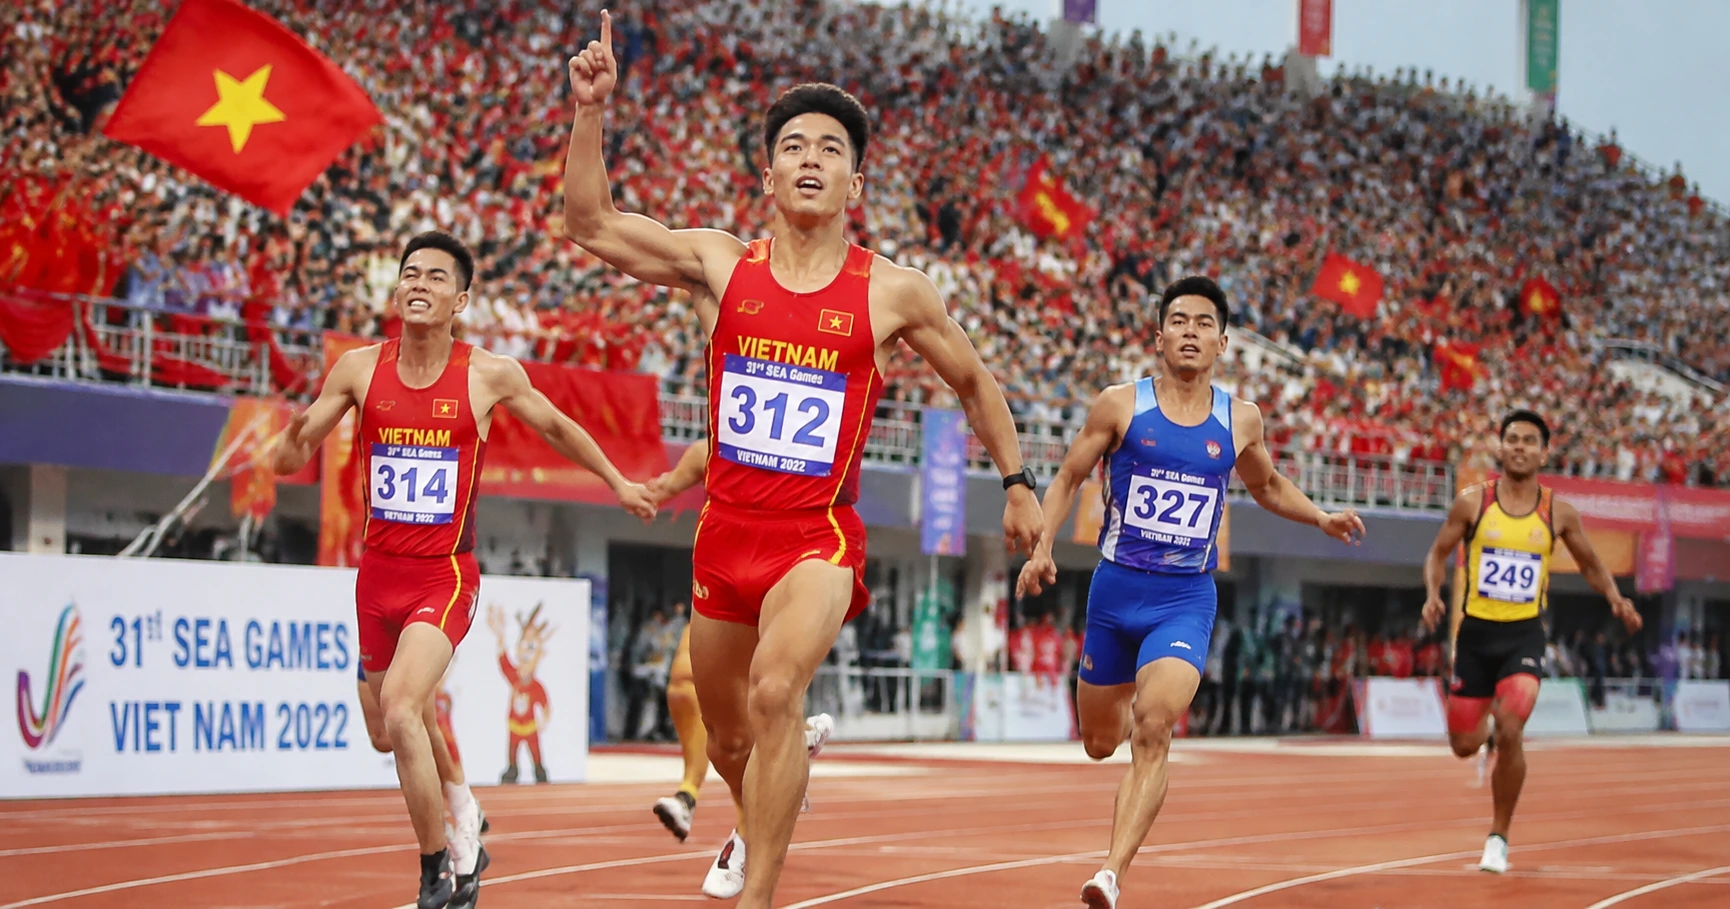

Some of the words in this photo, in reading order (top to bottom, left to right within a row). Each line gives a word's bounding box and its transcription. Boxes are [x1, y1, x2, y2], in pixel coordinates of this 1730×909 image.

[737, 335, 839, 372] VIETNAM
[765, 364, 787, 379] SEA
[789, 368, 824, 385] Games
[728, 384, 830, 448] 312
[378, 427, 451, 447] VIETNAM
[736, 449, 778, 468] VIETNAM
[780, 458, 806, 472] 2022
[377, 464, 448, 504] 314
[1133, 484, 1210, 528] 327
[1483, 560, 1535, 590] 249
[110, 609, 162, 668] 31st
[174, 617, 233, 668] SEA
[245, 619, 350, 670] GAMES
[110, 702, 182, 751] VIET
[194, 702, 265, 751] NAM
[277, 702, 348, 749] 2022
